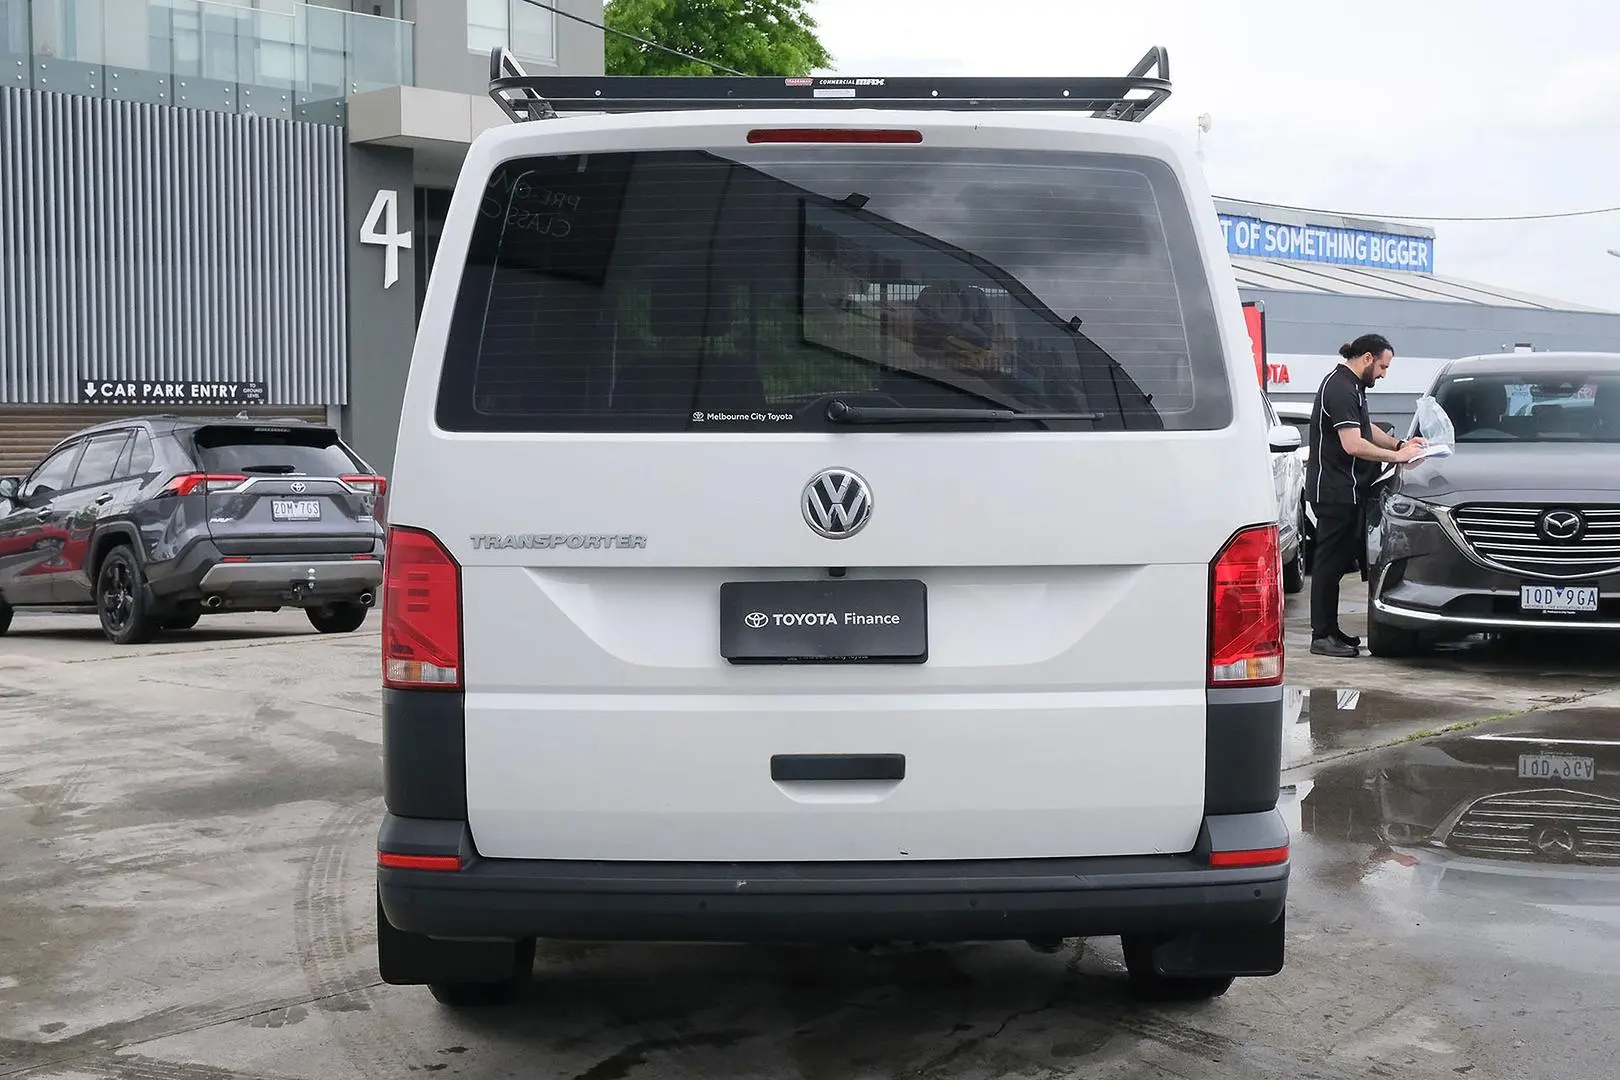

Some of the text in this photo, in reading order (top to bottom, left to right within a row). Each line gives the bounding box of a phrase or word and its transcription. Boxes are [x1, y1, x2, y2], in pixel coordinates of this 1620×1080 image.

[360, 189, 412, 290] 4
[1235, 221, 1261, 250] OF
[1264, 224, 1367, 261] SOMETHING
[1370, 236, 1428, 267] BIGGER
[100, 383, 238, 398] CAR PARK ENTRY
[706, 412, 793, 421] Melbourne City Toyota
[470, 534, 647, 549] TRANSPORTER
[773, 612, 900, 626] TOYOTA Finance
